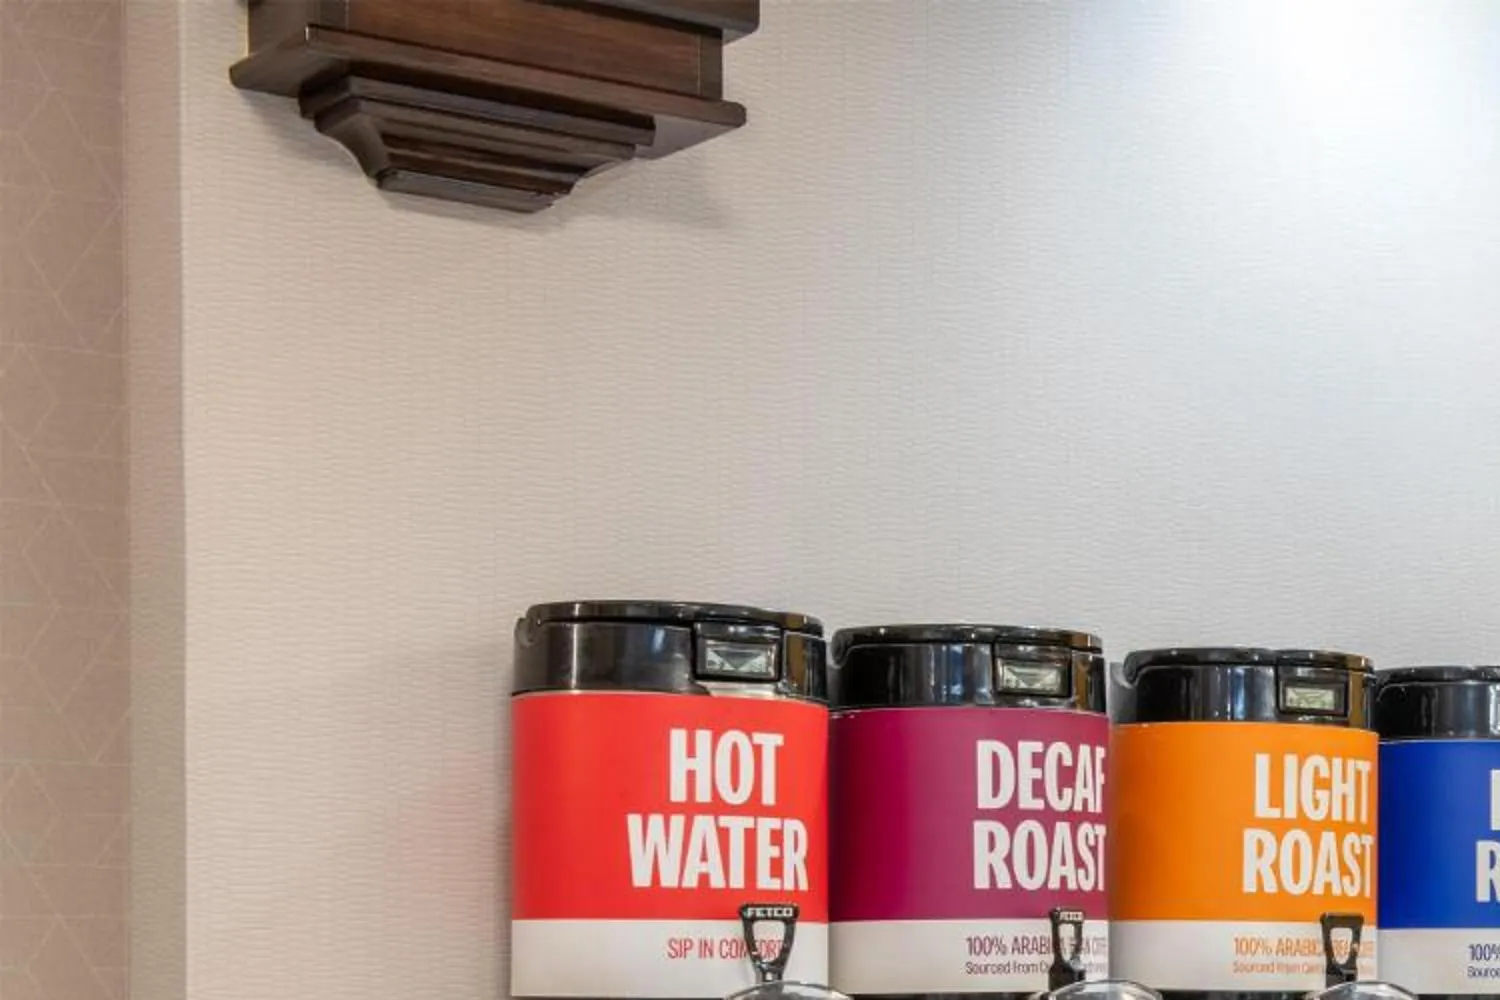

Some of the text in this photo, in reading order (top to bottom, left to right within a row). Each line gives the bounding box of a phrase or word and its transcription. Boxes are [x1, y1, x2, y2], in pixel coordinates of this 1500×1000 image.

[669, 728, 784, 806] HOT
[976, 740, 1106, 813] DECAF
[1254, 753, 1372, 822] LIGHT
[626, 813, 808, 891] WATER
[973, 820, 1107, 892] ROAST
[1243, 828, 1374, 898] ROAST
[747, 907, 793, 917] FETCO
[966, 936, 1007, 956] 100%
[1234, 937, 1272, 955] 100%
[667, 938, 693, 959] SIP
[699, 938, 714, 959] IN
